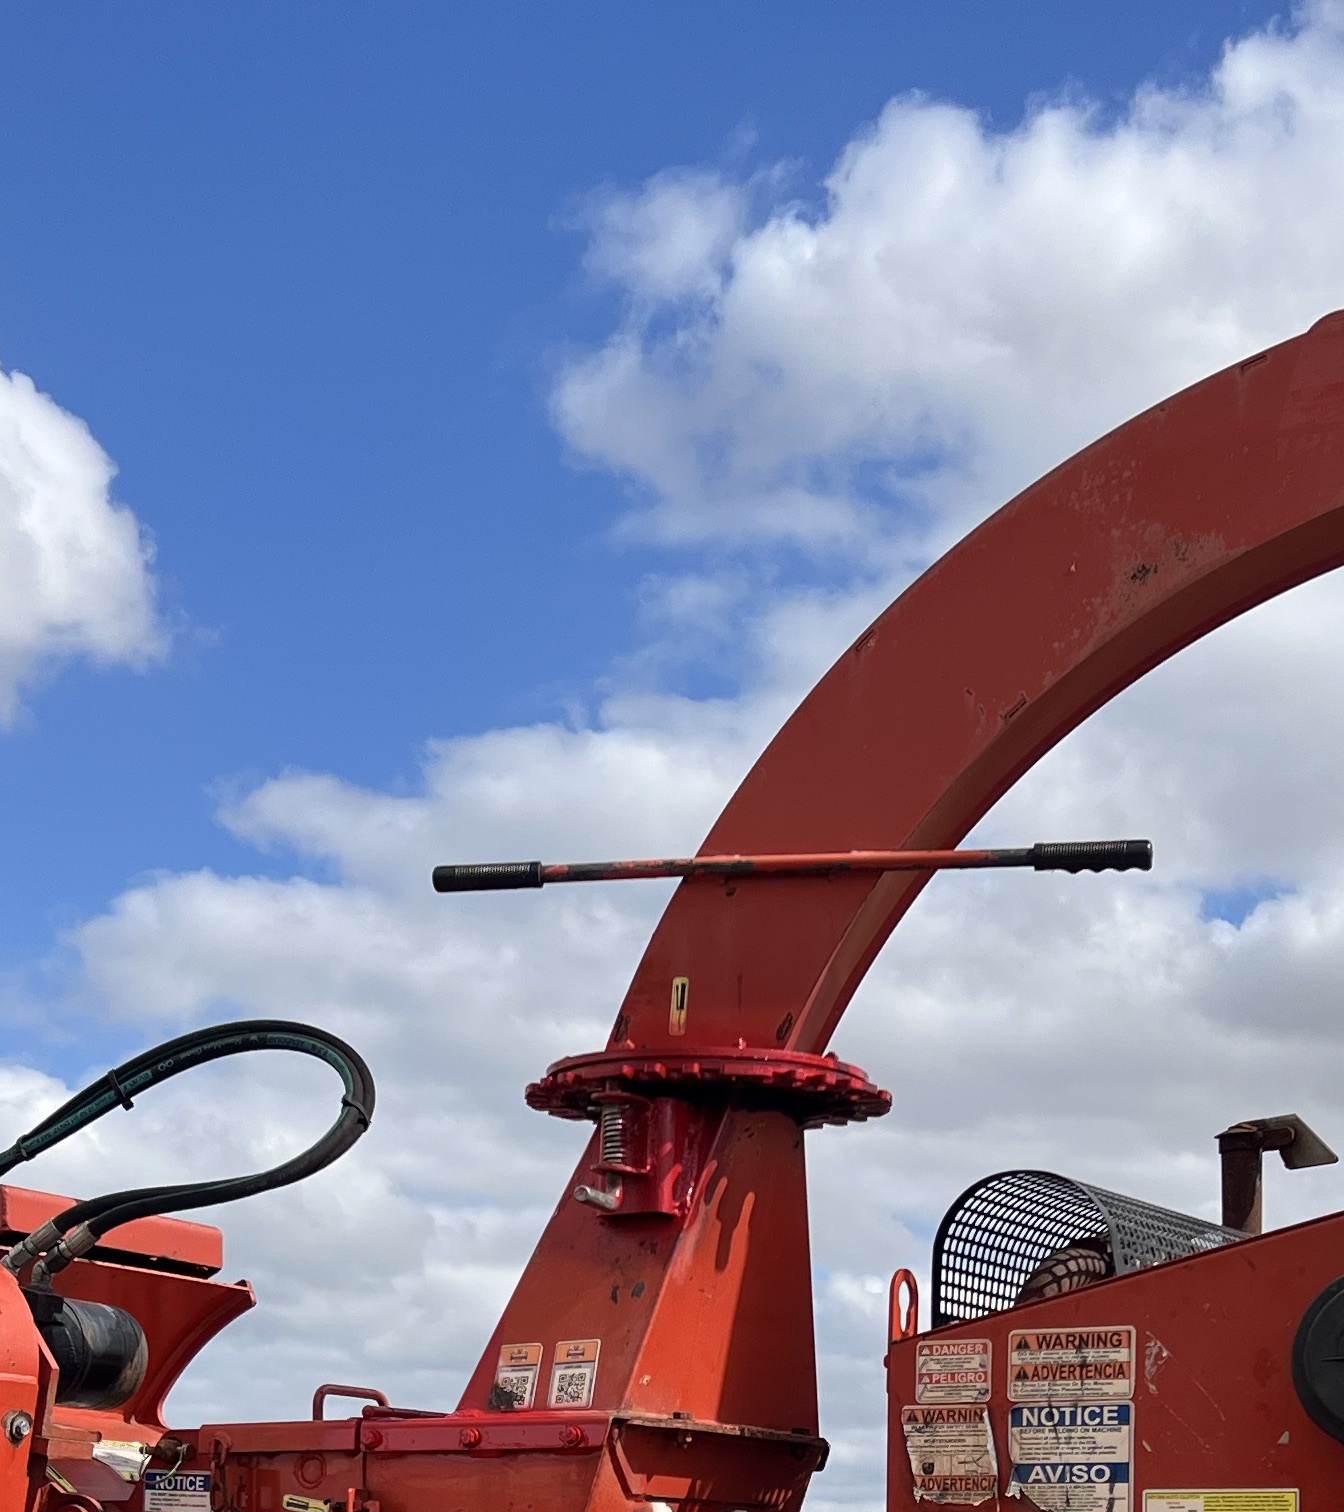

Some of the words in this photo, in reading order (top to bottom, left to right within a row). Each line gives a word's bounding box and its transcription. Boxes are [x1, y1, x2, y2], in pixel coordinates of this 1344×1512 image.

[1036, 1333, 1122, 1349] WARNING
[933, 1344, 983, 1355] DANGER
[932, 1372, 984, 1383] PELIGRO
[1031, 1363, 1125, 1380] ADVERTENCIA
[922, 1409, 984, 1423] WARNIN
[1022, 1406, 1119, 1426] NOTICE
[1028, 1465, 1110, 1483] AVISO
[156, 1475, 204, 1491] NOTICE
